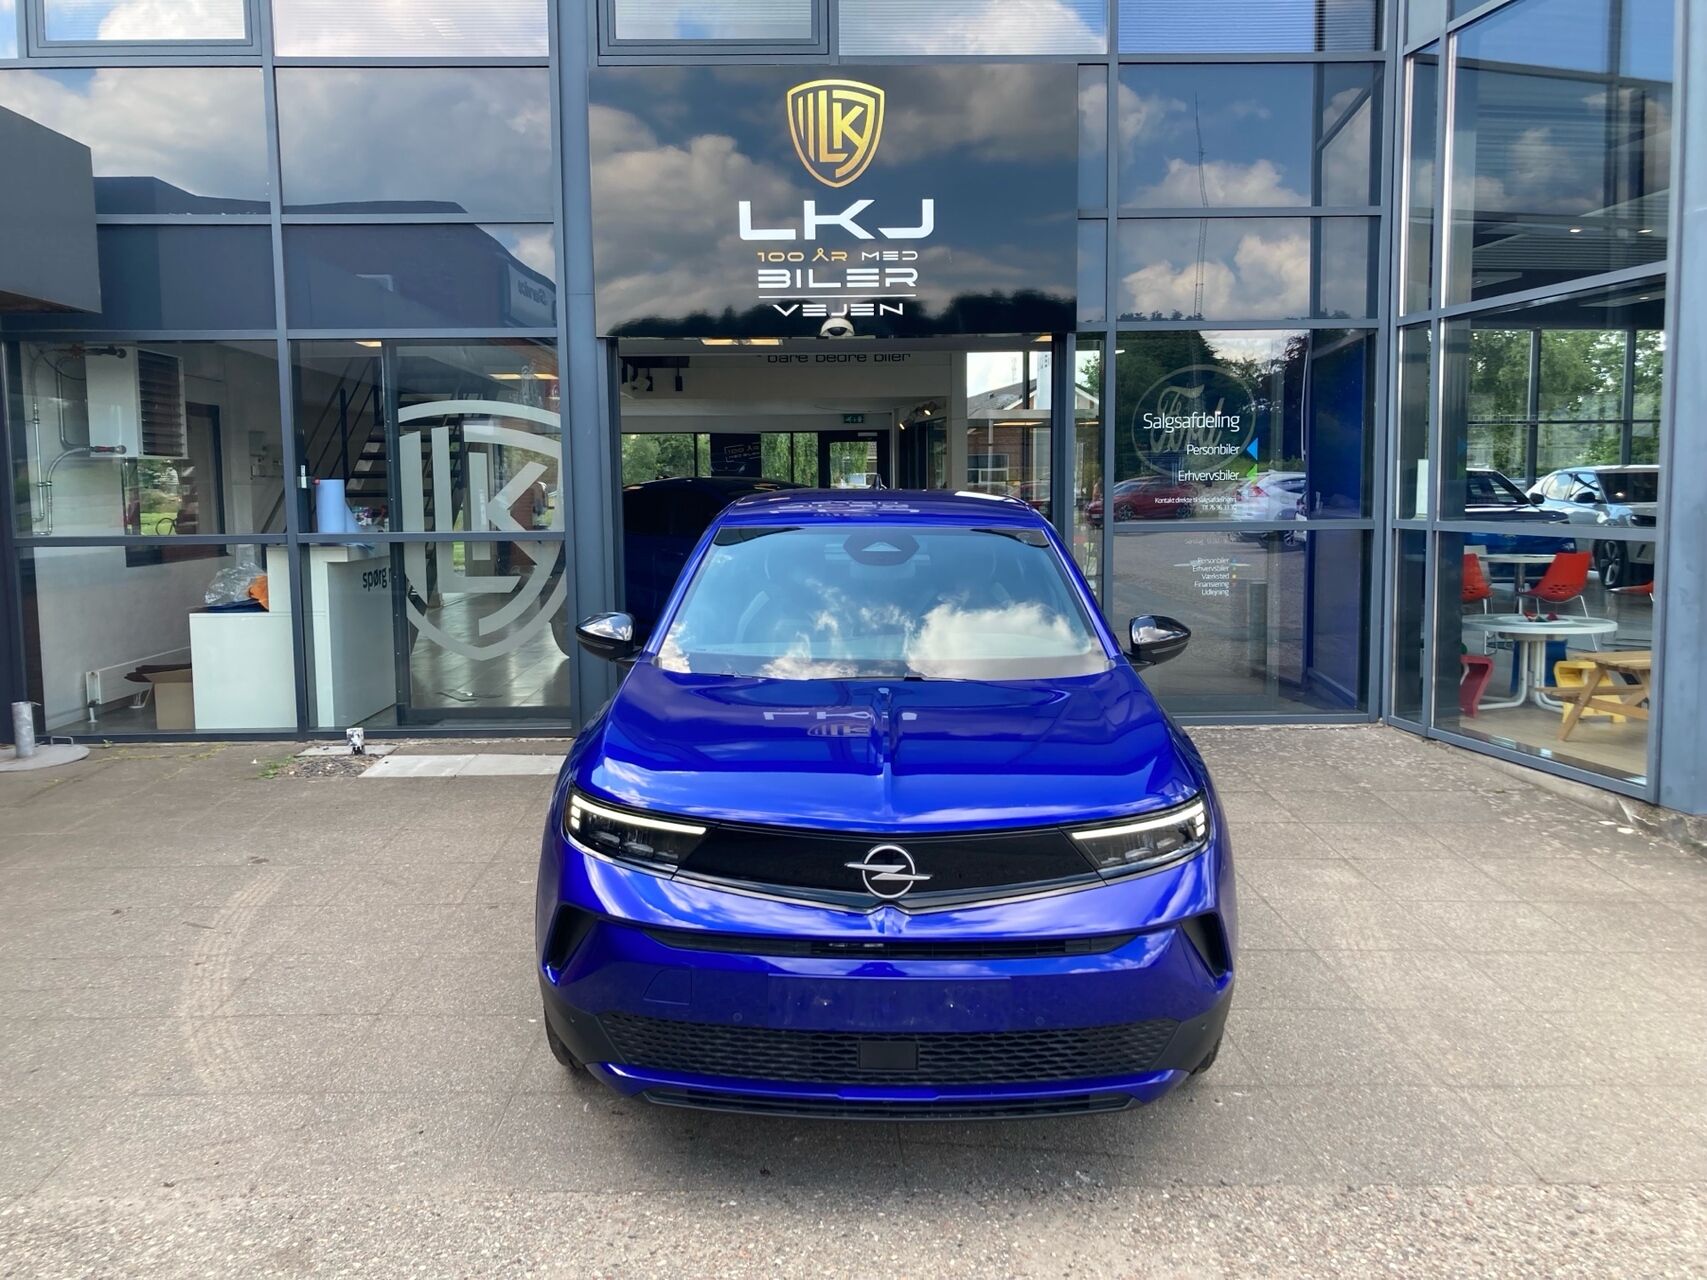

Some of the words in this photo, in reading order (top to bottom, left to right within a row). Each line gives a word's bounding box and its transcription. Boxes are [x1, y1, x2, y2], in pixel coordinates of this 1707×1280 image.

[739, 198, 934, 240] LKJ
[757, 251, 805, 262] 100
[812, 247, 848, 262] ÅR
[861, 250, 919, 261] MED
[757, 267, 919, 289] BILER
[772, 302, 903, 317] VEJEN
[1143, 411, 1240, 433] Salgsafdeling
[1186, 444, 1240, 455] Personbiler
[1178, 470, 1240, 481] Erhvervsbiler
[362, 567, 388, 592] spørg
